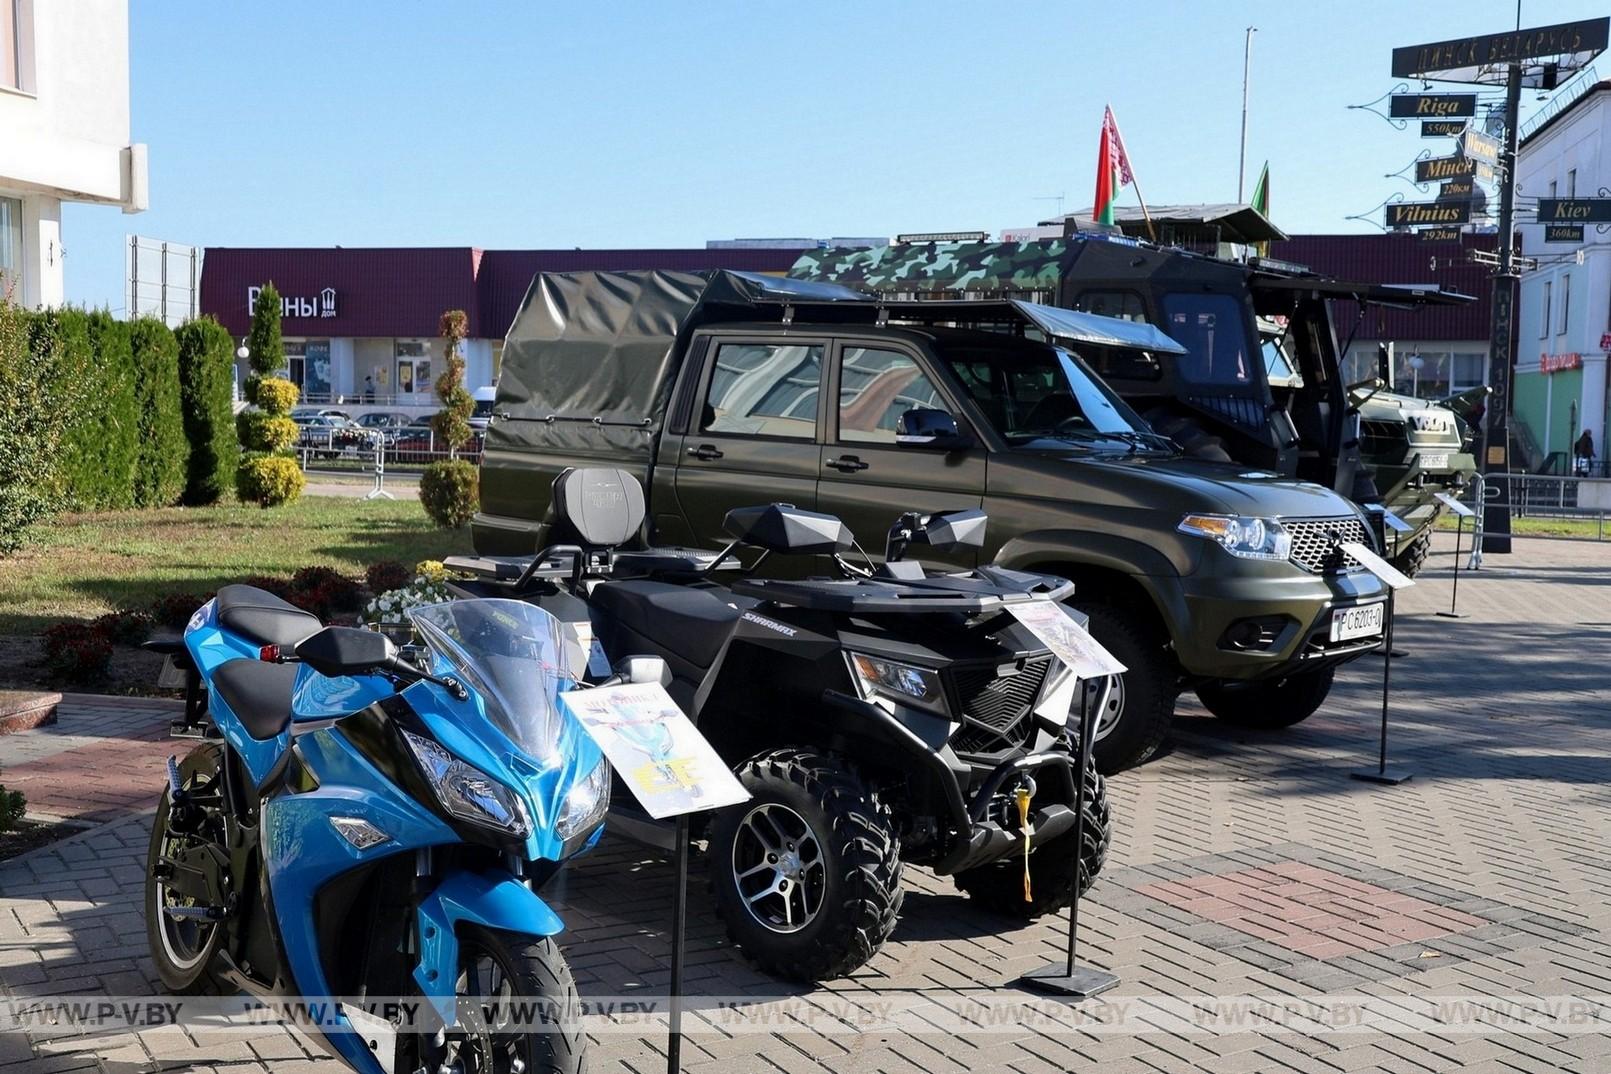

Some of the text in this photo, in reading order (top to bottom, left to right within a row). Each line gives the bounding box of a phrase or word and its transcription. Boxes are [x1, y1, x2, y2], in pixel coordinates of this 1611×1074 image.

[1416, 97, 1460, 116] Riga
[1395, 204, 1460, 222] Vilnius
[1554, 202, 1591, 218] Kiev
[1422, 229, 1458, 241] 292km
[741, 612, 798, 637] SHARMAX
